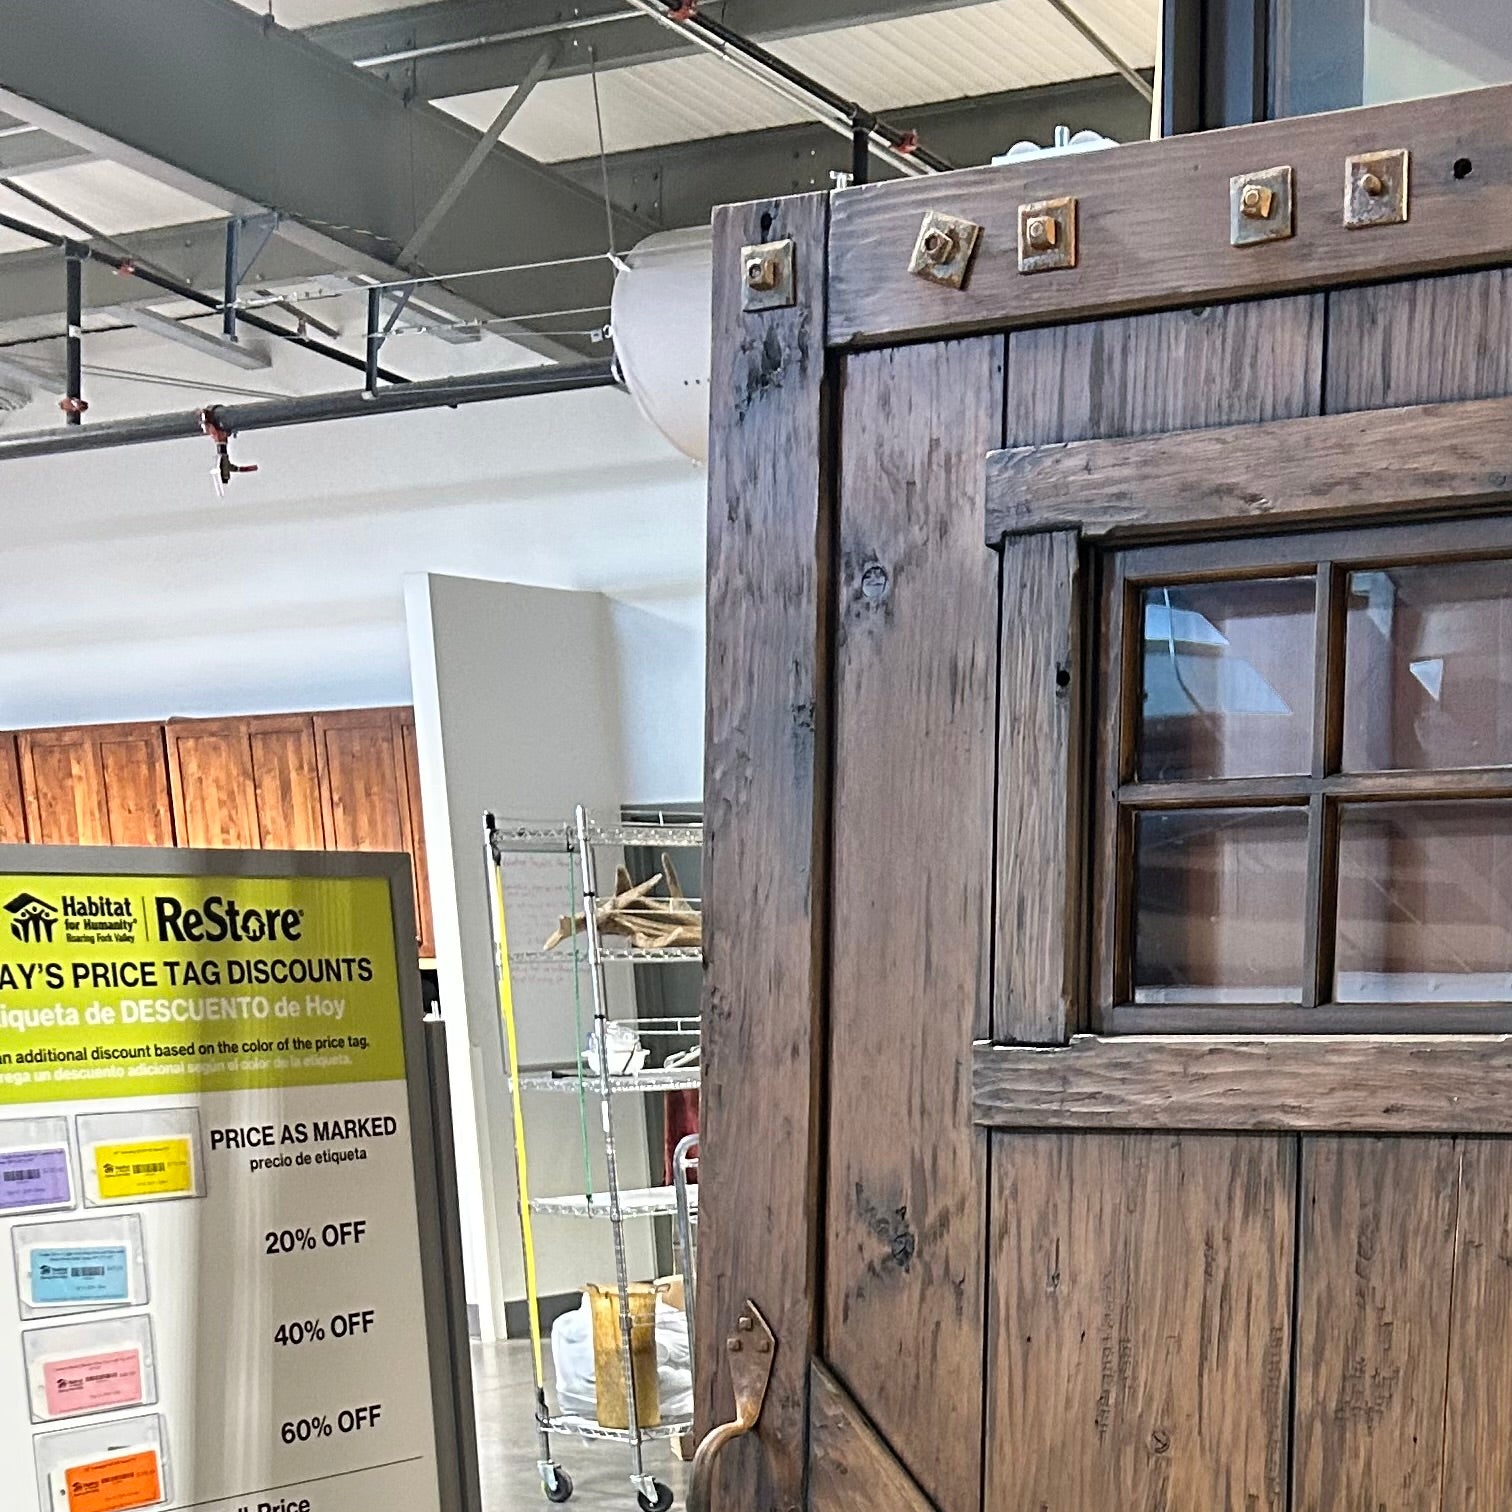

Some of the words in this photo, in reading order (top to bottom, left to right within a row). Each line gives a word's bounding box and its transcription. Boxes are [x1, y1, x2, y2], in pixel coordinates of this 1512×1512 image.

[62, 896, 132, 917] Habitat
[155, 896, 302, 942] ReStore
[65, 919, 80, 930] for
[66, 933, 95, 944] Roaring
[96, 932, 113, 942] Fork
[114, 933, 135, 944] Valley
[72, 961, 158, 989] PRICE
[162, 960, 220, 986] TAG
[226, 958, 373, 985] DISCOUNTS
[84, 1001, 115, 1026] de
[120, 996, 269, 1023] DESCUENTO
[274, 997, 300, 1017] de
[305, 995, 346, 1020] Hoy
[16, 1047, 88, 1064] additional
[91, 1045, 151, 1061] discount
[154, 1042, 195, 1057] based
[198, 1042, 215, 1055] on
[218, 1040, 239, 1054] the
[242, 1039, 273, 1053] color
[277, 1037, 290, 1050] of
[293, 1036, 312, 1050] the
[315, 1035, 345, 1052] price
[347, 1035, 370, 1049] tag.
[34, 1070, 52, 1082] un
[54, 1064, 125, 1082] descuento
[128, 1061, 184, 1077] adicional
[210, 1126, 275, 1150] PRICE
[280, 1123, 308, 1144] AS
[313, 1116, 396, 1142] MARKED
[250, 1154, 292, 1172] precio
[295, 1152, 312, 1166] de
[315, 1148, 367, 1165] etiqueta
[265, 1228, 316, 1254] 20%
[322, 1220, 367, 1247] OFF
[274, 1318, 325, 1346] 40%
[330, 1310, 375, 1338] OFF
[281, 1415, 333, 1444] 60%
[337, 1404, 381, 1433] OFF
